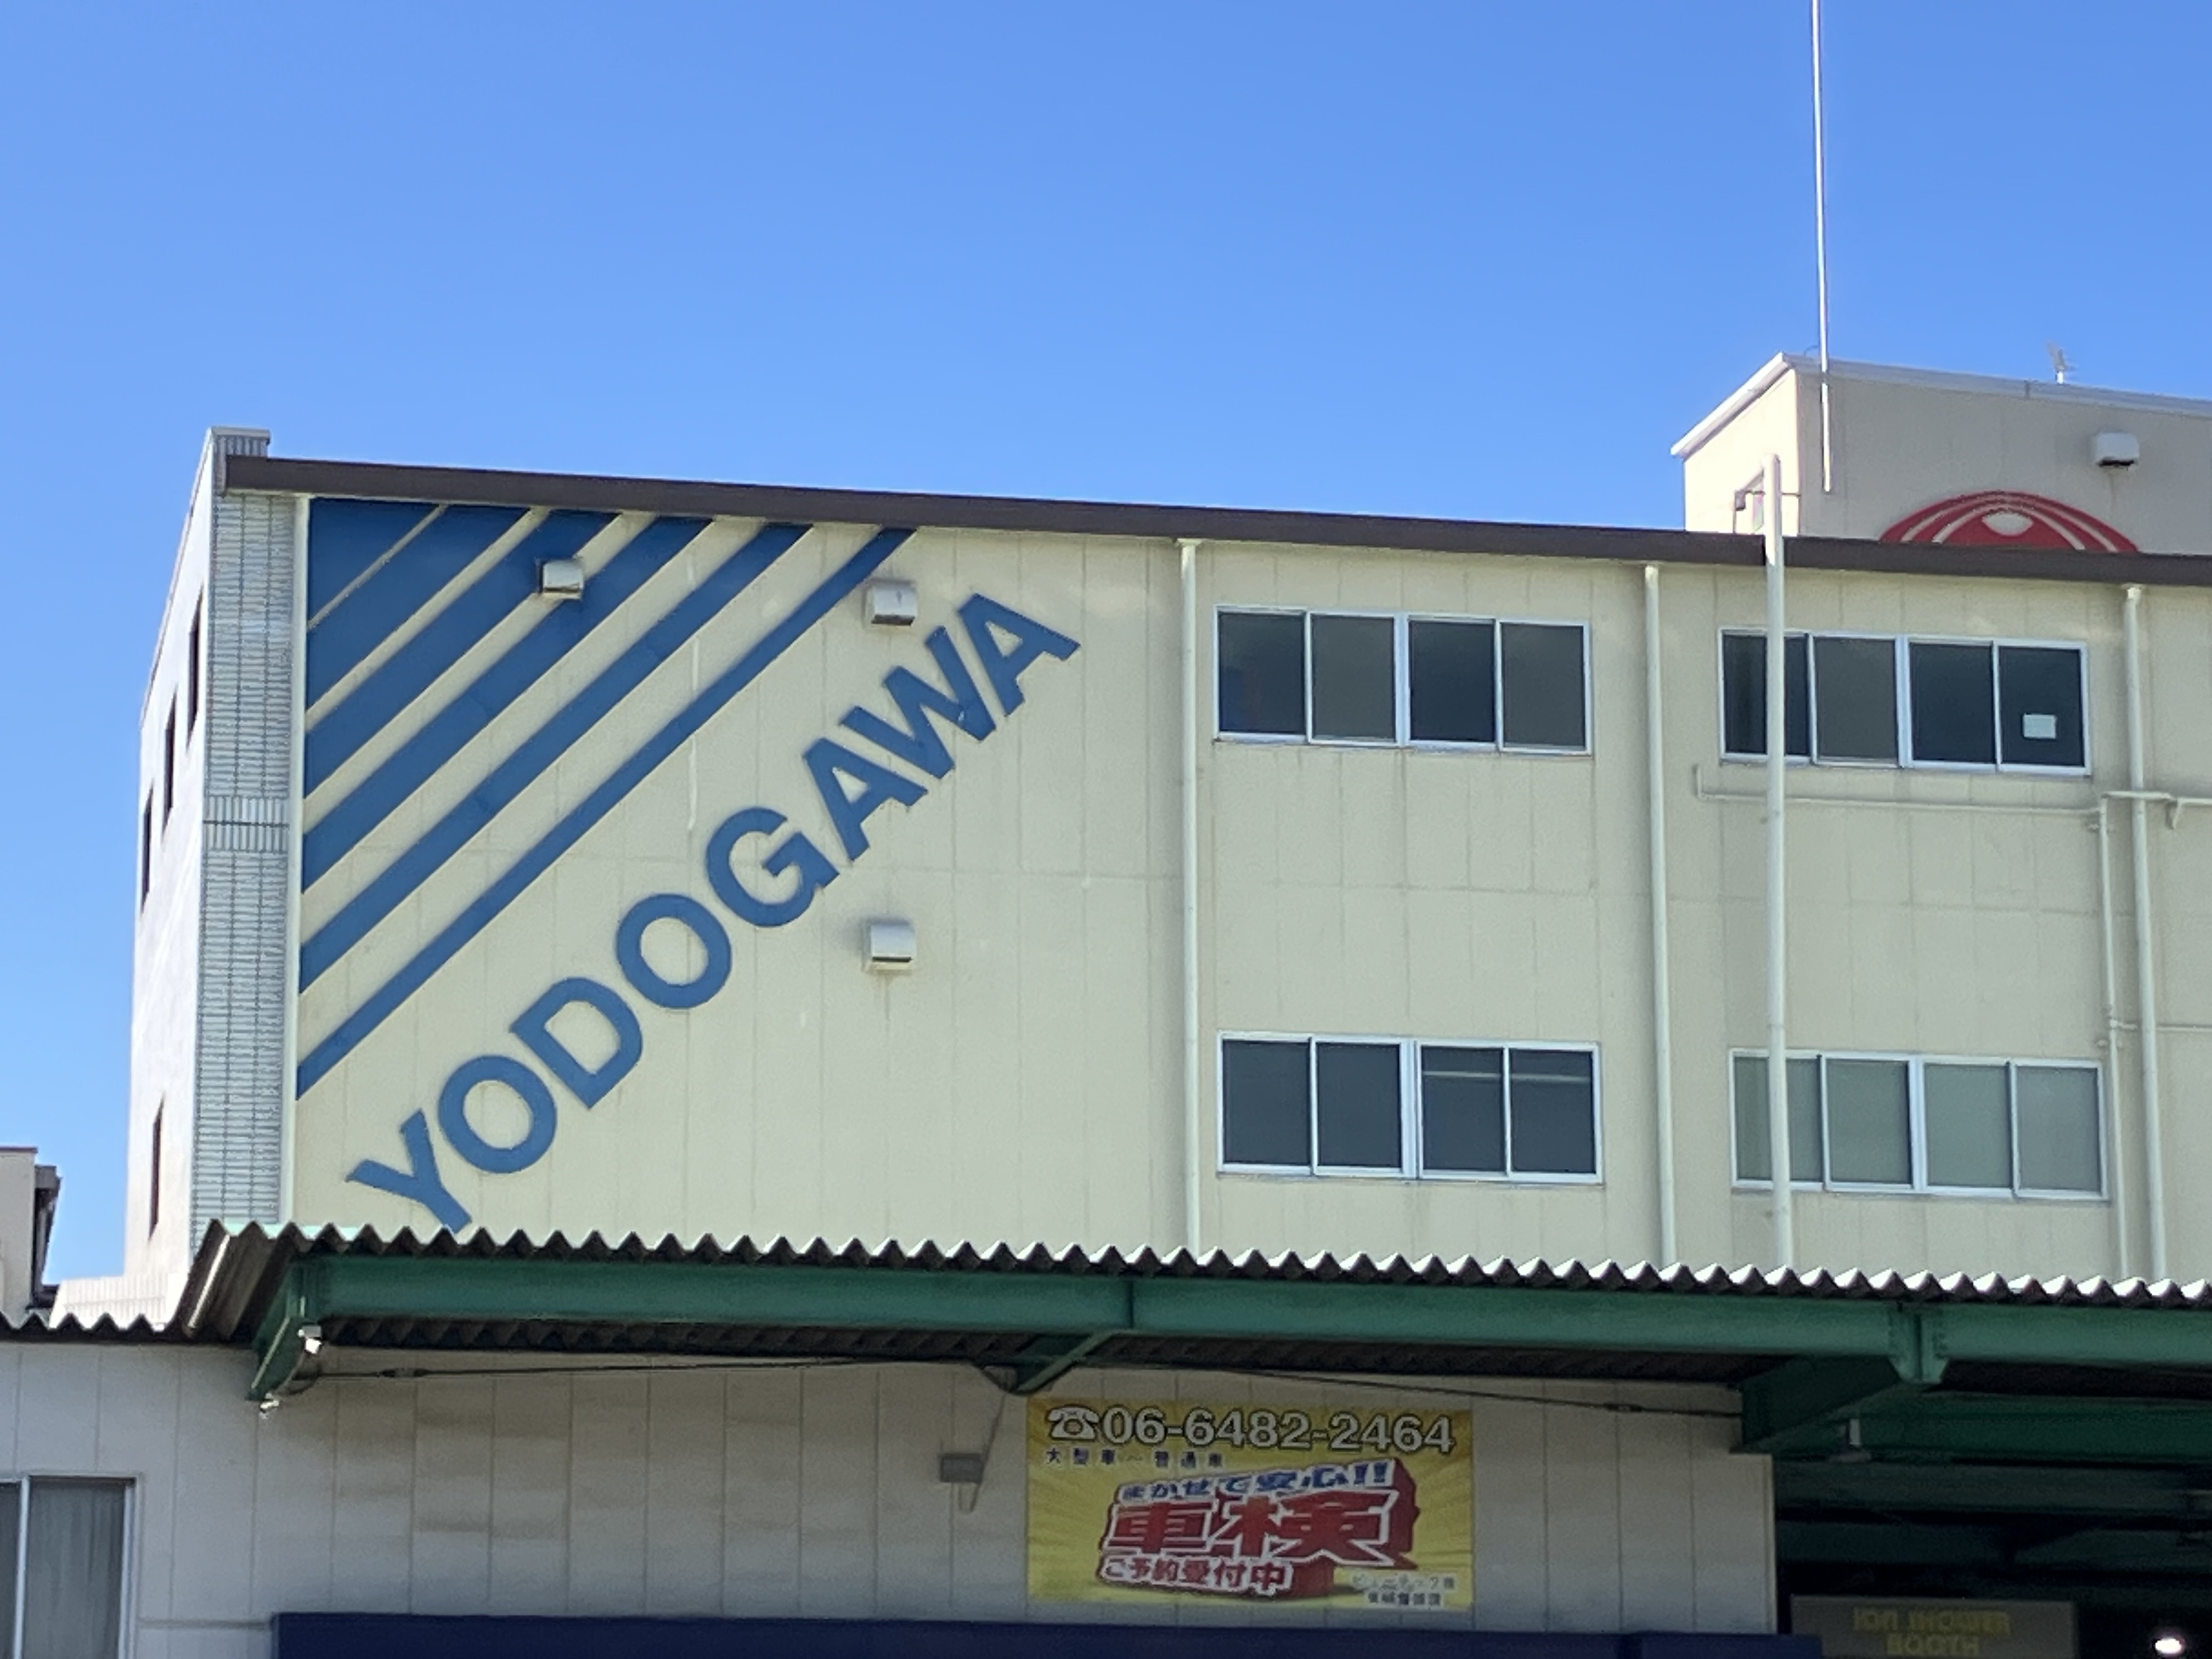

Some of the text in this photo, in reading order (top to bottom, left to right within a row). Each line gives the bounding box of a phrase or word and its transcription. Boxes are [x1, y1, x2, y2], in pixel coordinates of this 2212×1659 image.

[346, 592, 1080, 1234] YODOGAWA
[1103, 1404, 1456, 1454] 06-6482-2464
[1105, 1489, 1396, 1565] 車検
[1104, 1558, 1287, 1591] ご予約受付中
